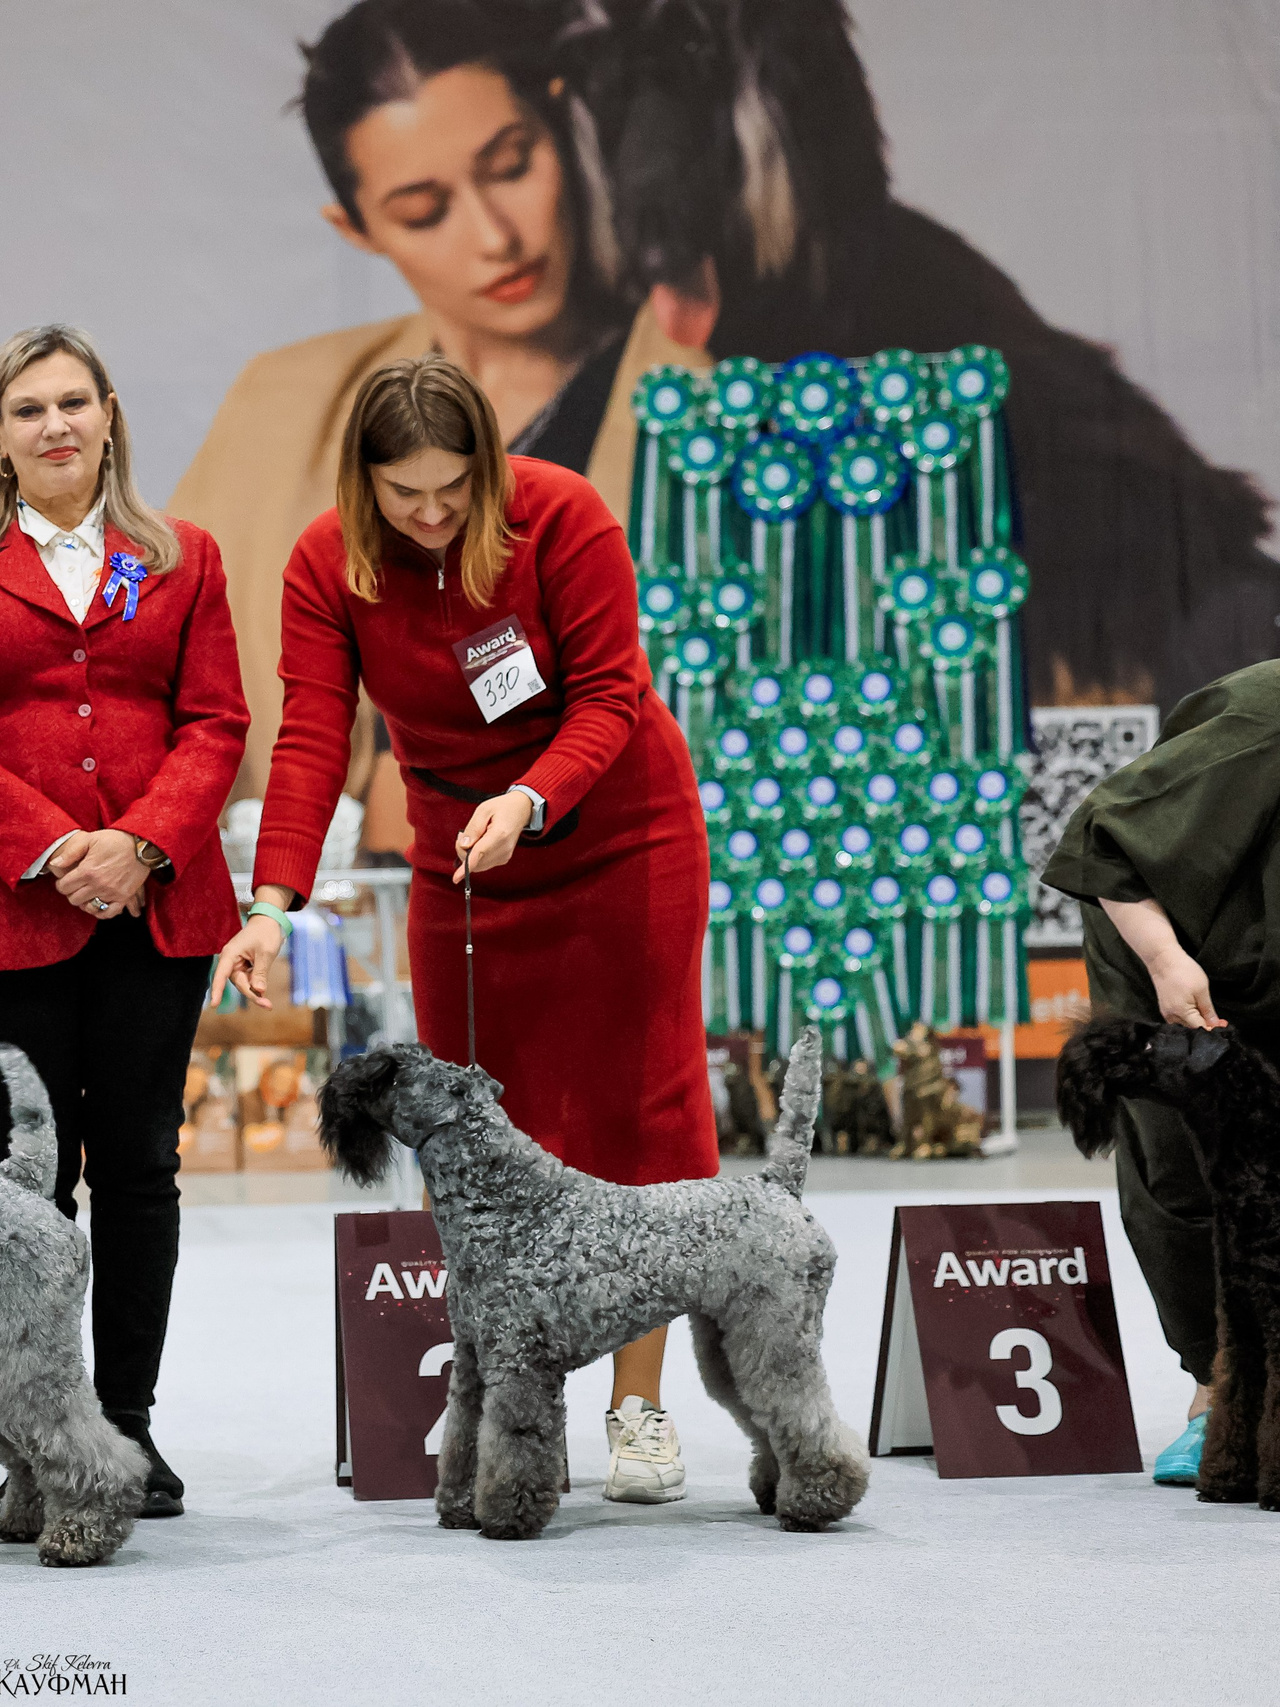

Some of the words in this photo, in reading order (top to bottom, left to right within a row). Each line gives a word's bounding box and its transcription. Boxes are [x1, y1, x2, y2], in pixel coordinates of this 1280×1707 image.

[467, 626, 517, 662] Award
[484, 666, 520, 707] 330
[933, 1247, 1088, 1288] Award
[989, 1327, 1063, 1436] 3
